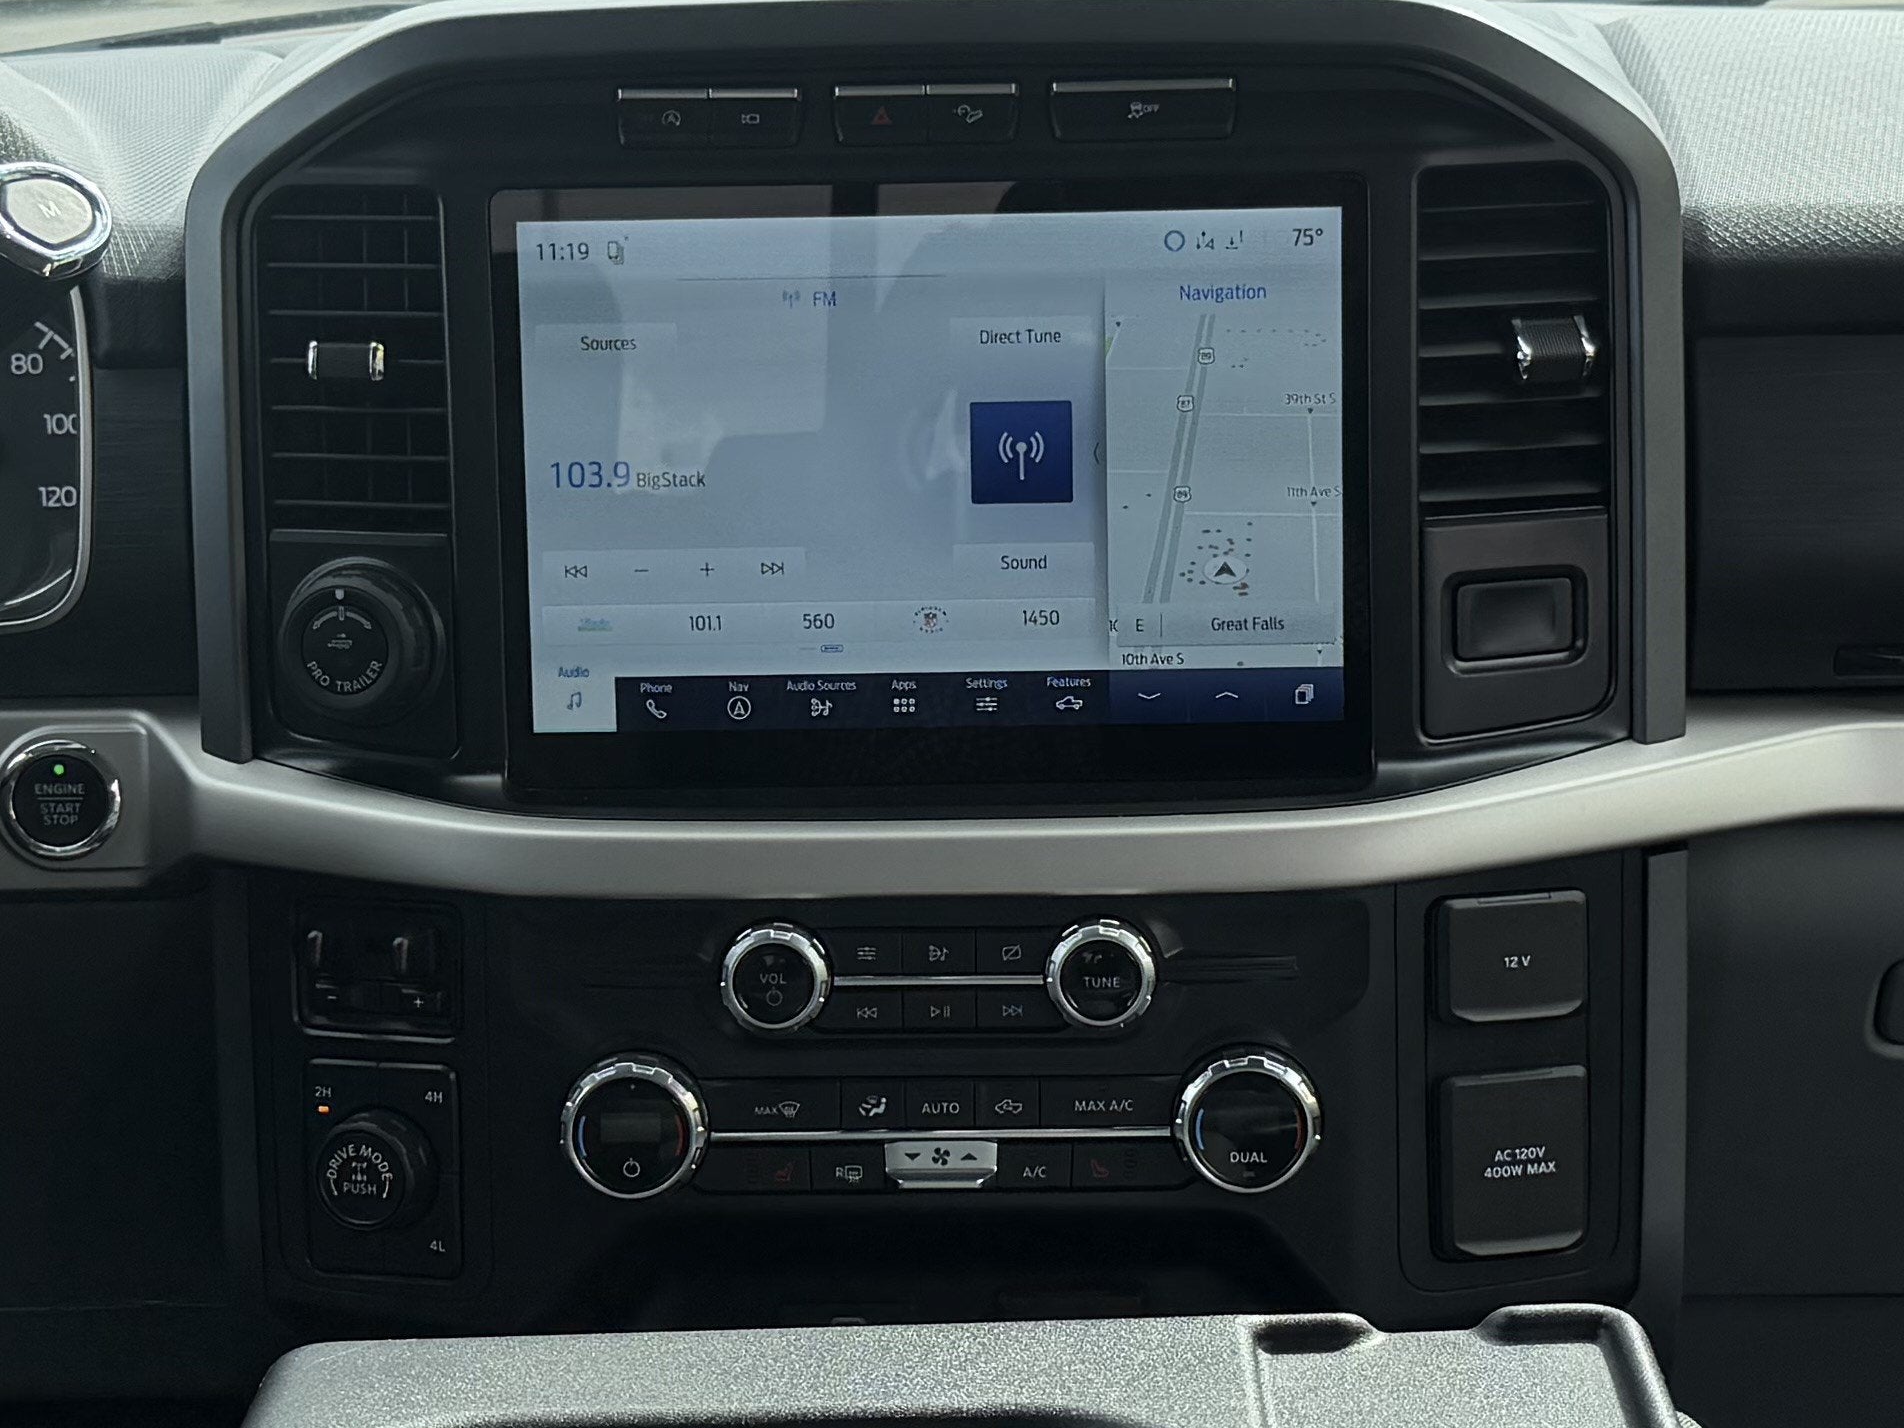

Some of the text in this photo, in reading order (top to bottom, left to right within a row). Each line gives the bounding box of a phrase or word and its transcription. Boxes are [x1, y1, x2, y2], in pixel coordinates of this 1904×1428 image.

[41, 201, 60, 218] M
[536, 242, 589, 261] 11:19
[813, 291, 837, 307] FM
[1180, 284, 1267, 303] Navigation
[980, 328, 1062, 345] Direct Tune
[581, 336, 637, 351] Sources
[10, 353, 43, 375] 80
[1314, 394, 1327, 404] St
[1329, 393, 1337, 404] S
[550, 460, 707, 491] 103.9 BigStack
[38, 486, 78, 507] 120
[1310, 486, 1333, 498] Ave
[1334, 486, 1342, 497] S
[1001, 554, 1048, 570] Sound
[689, 615, 723, 631] 101.1
[802, 613, 835, 629] 560
[1022, 609, 1060, 626] 1450
[1211, 616, 1285, 632] Great Falls
[1136, 618, 1144, 632] E
[1122, 653, 1184, 665] 10th Ave S
[307, 660, 383, 692] PRO TRAILER
[558, 666, 590, 679] Audio
[640, 683, 673, 694] Phone
[729, 681, 749, 692] Nav
[786, 679, 857, 691] Audio Sources
[891, 679, 917, 691] Apps
[965, 677, 1008, 690] Settings
[1046, 676, 1091, 688] Features
[34, 783, 86, 795] ENGINE
[40, 803, 81, 814] START
[43, 814, 79, 826] STOP
[1504, 955, 1531, 968] 12 V
[759, 973, 787, 985] VOL
[1082, 977, 1121, 989] TUNE
[315, 1086, 332, 1098] 2H
[425, 1091, 443, 1104] 4H
[755, 1106, 779, 1116] MAX
[921, 1102, 960, 1115] AUTO
[1074, 1099, 1134, 1112] MAX A/C
[1230, 1152, 1268, 1164] DUAL
[1495, 1146, 1546, 1162] AC 120V
[326, 1144, 393, 1181] DRIVE MODE
[835, 1167, 844, 1179] R
[1023, 1165, 1046, 1179] A/C
[1484, 1161, 1556, 1179] 400W MAX
[343, 1182, 377, 1196] PUSH
[430, 1239, 446, 1253] 4L
